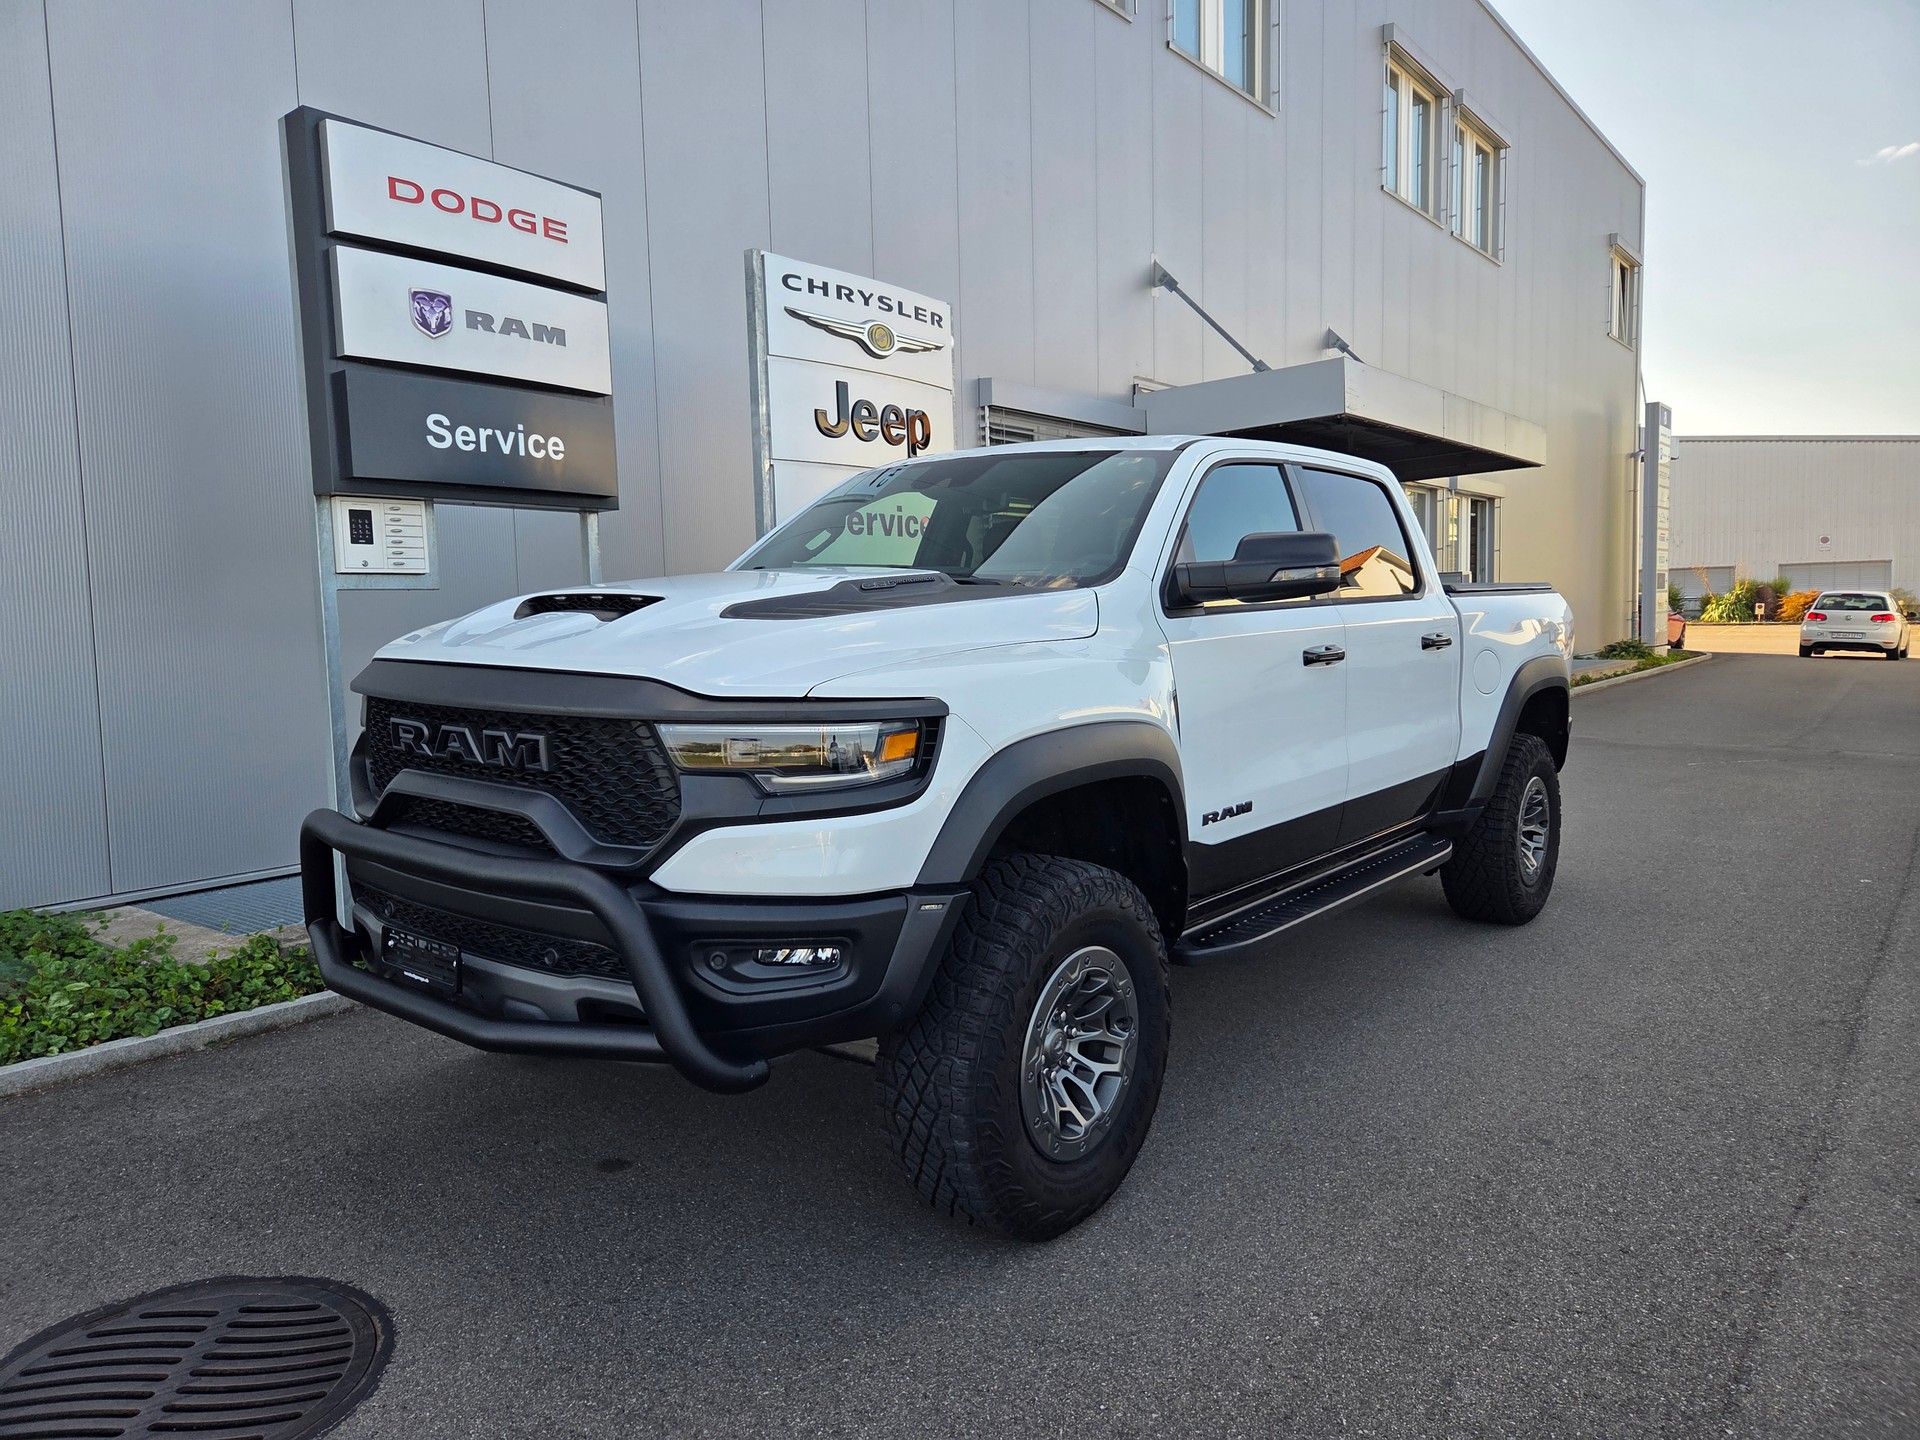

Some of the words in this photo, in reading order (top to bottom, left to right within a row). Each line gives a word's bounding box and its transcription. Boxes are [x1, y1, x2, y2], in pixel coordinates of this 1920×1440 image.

[387, 175, 568, 244] DODGE
[781, 273, 944, 329] CHRYSLER
[465, 309, 567, 347] RAM
[426, 413, 565, 461] Service
[814, 380, 931, 458] Jeep
[847, 505, 930, 538] ervic
[390, 717, 549, 772] RAM
[1201, 800, 1252, 827] RAM
